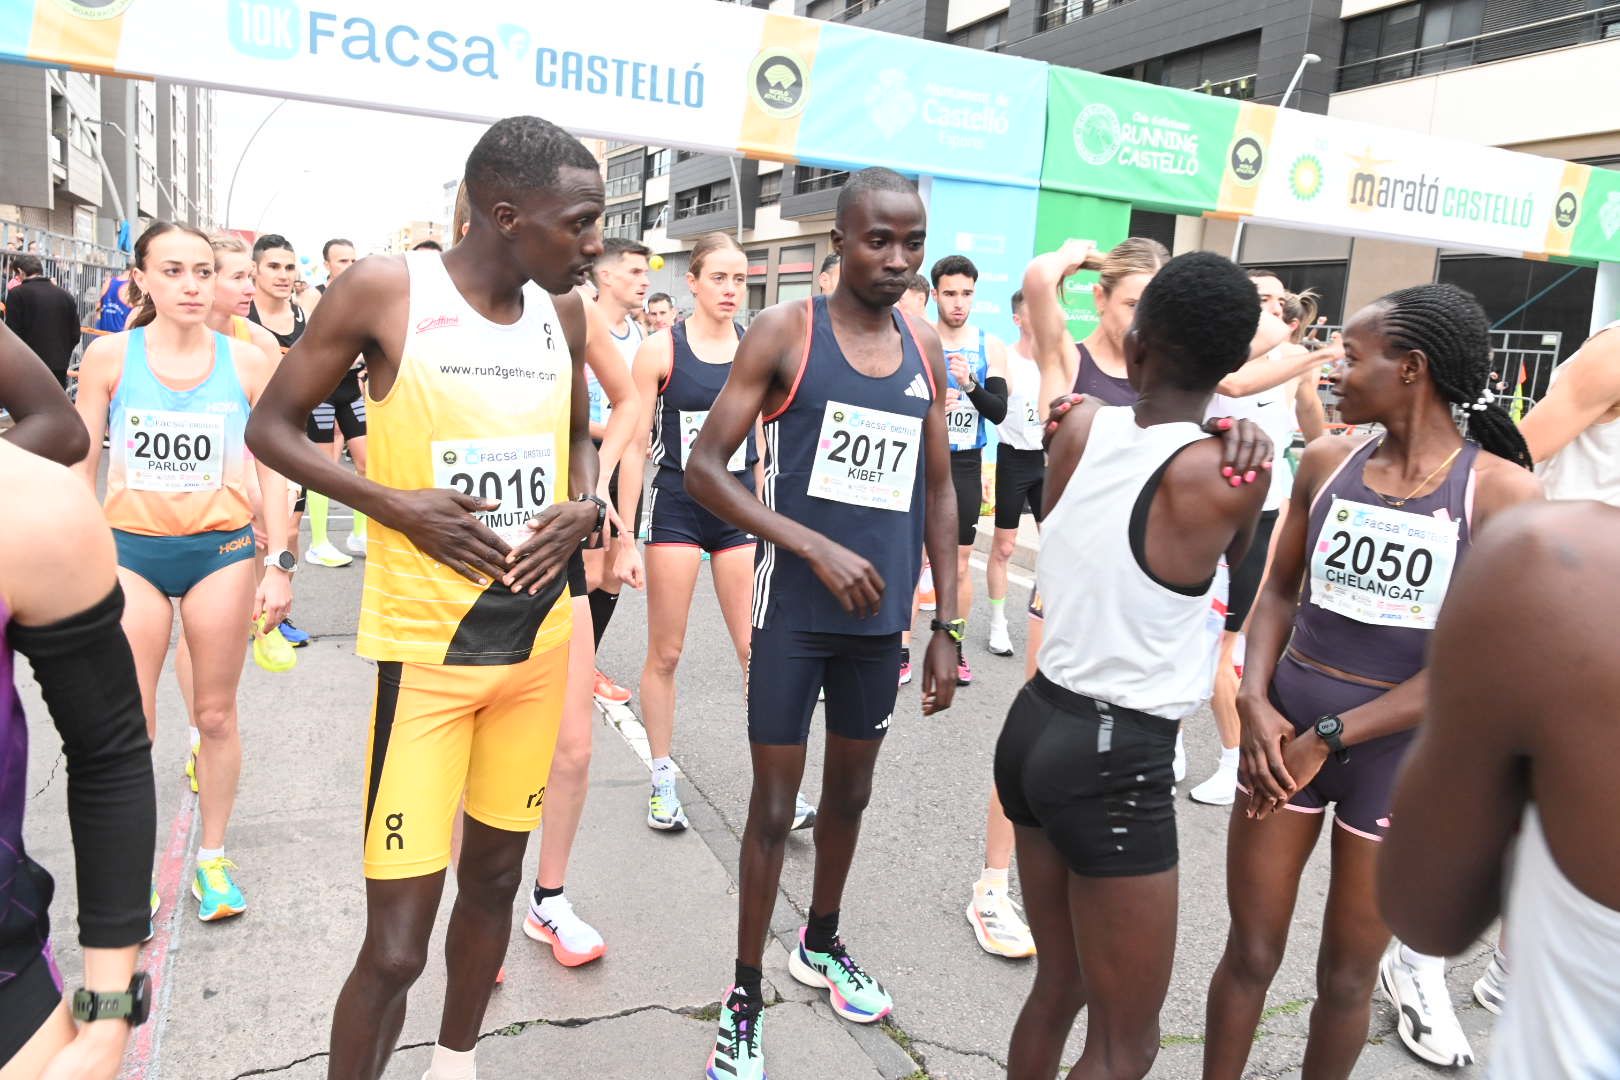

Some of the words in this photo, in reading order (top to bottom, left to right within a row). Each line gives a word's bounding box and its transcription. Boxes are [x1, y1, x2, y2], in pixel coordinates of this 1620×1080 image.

[240, 0, 294, 49] 10K
[308, 11, 498, 80] Facsa
[535, 46, 705, 109] CASTELLÓ
[1120, 123, 1199, 153] RUNNING
[1349, 172, 1440, 215] marató
[1442, 186, 1535, 228] CASTELLÓ
[134, 431, 211, 461] 2060
[827, 430, 908, 472] 2017
[148, 460, 197, 472] PARLOV
[847, 467, 884, 483] KIBET
[450, 466, 545, 513] 2016
[219, 535, 252, 555] HOKA
[1325, 530, 1433, 587] 2050
[1326, 569, 1425, 602] CHELANGAT
